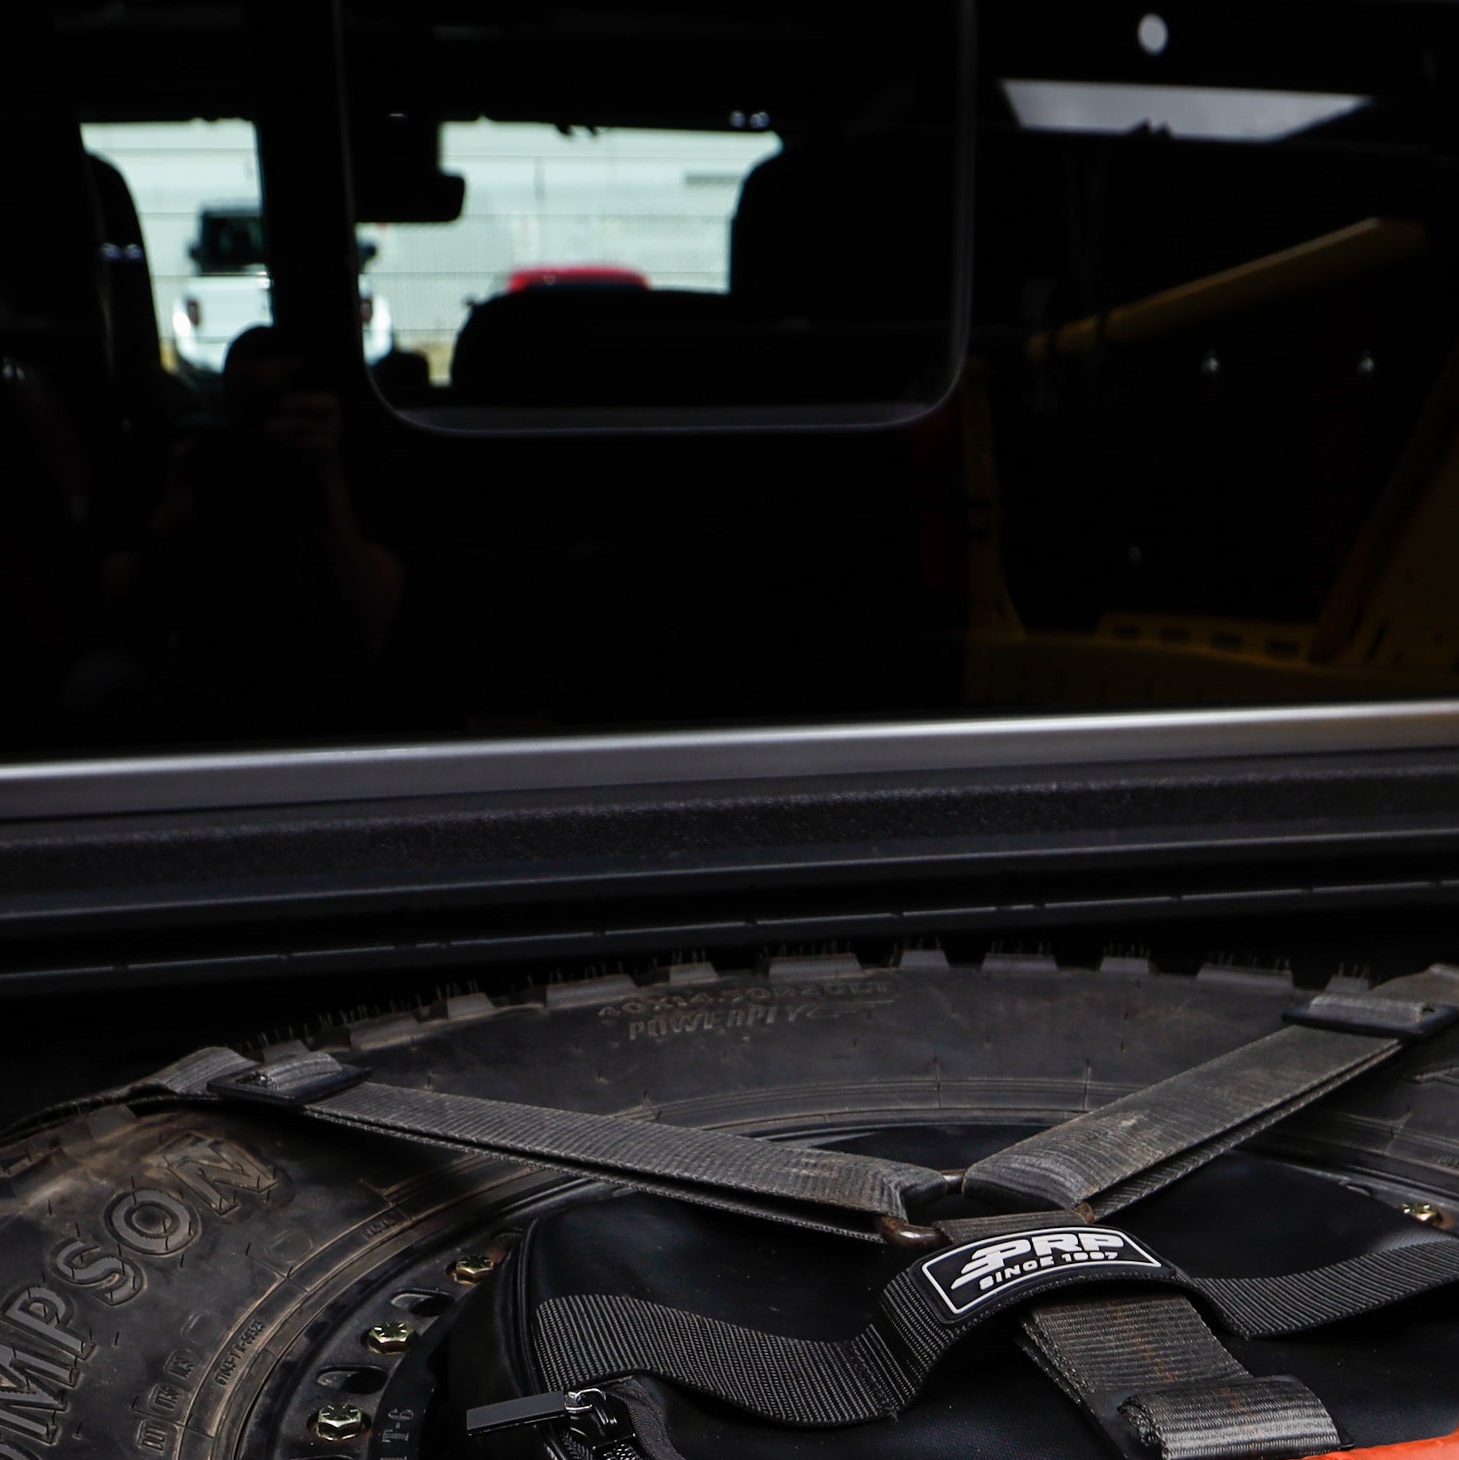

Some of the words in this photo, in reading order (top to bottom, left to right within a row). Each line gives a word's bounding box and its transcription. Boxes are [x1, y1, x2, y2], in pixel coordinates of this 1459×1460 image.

[950, 1232, 1125, 1291] PRP
[979, 1255, 1056, 1291] SINCE
[144, 1416, 167, 1452] DOT
[379, 1405, 416, 1446] T-6
